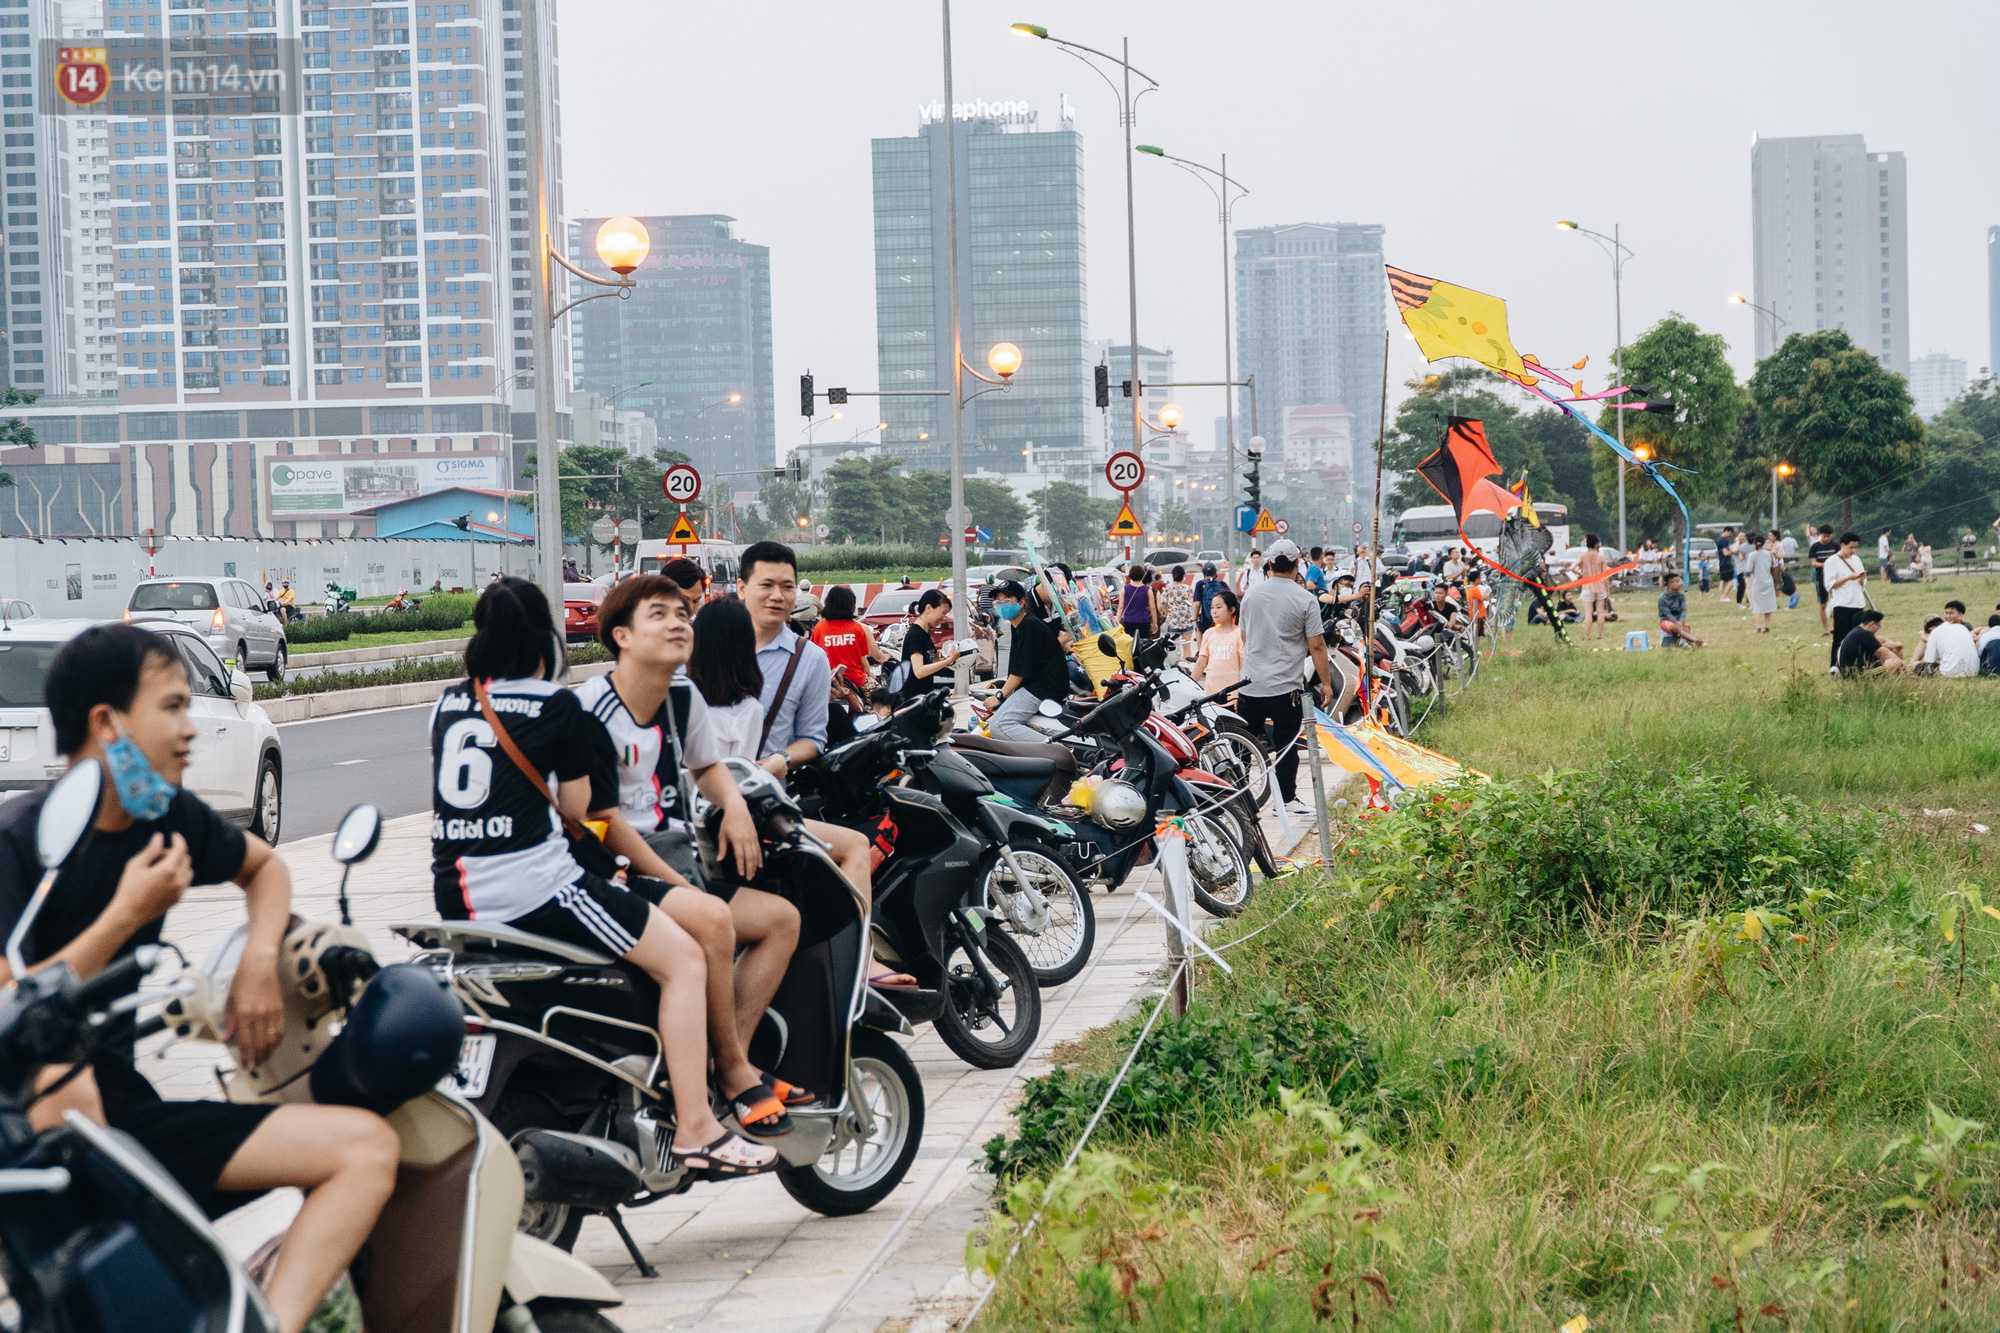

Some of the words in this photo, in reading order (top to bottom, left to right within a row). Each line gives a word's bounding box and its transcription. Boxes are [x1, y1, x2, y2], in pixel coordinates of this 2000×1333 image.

[285, 470, 332, 481] apave
[1114, 462, 1138, 480] 20
[671, 475, 695, 493] 20
[824, 633, 856, 648] STAFF
[438, 717, 499, 810] 6
[944, 860, 970, 868] HONDA
